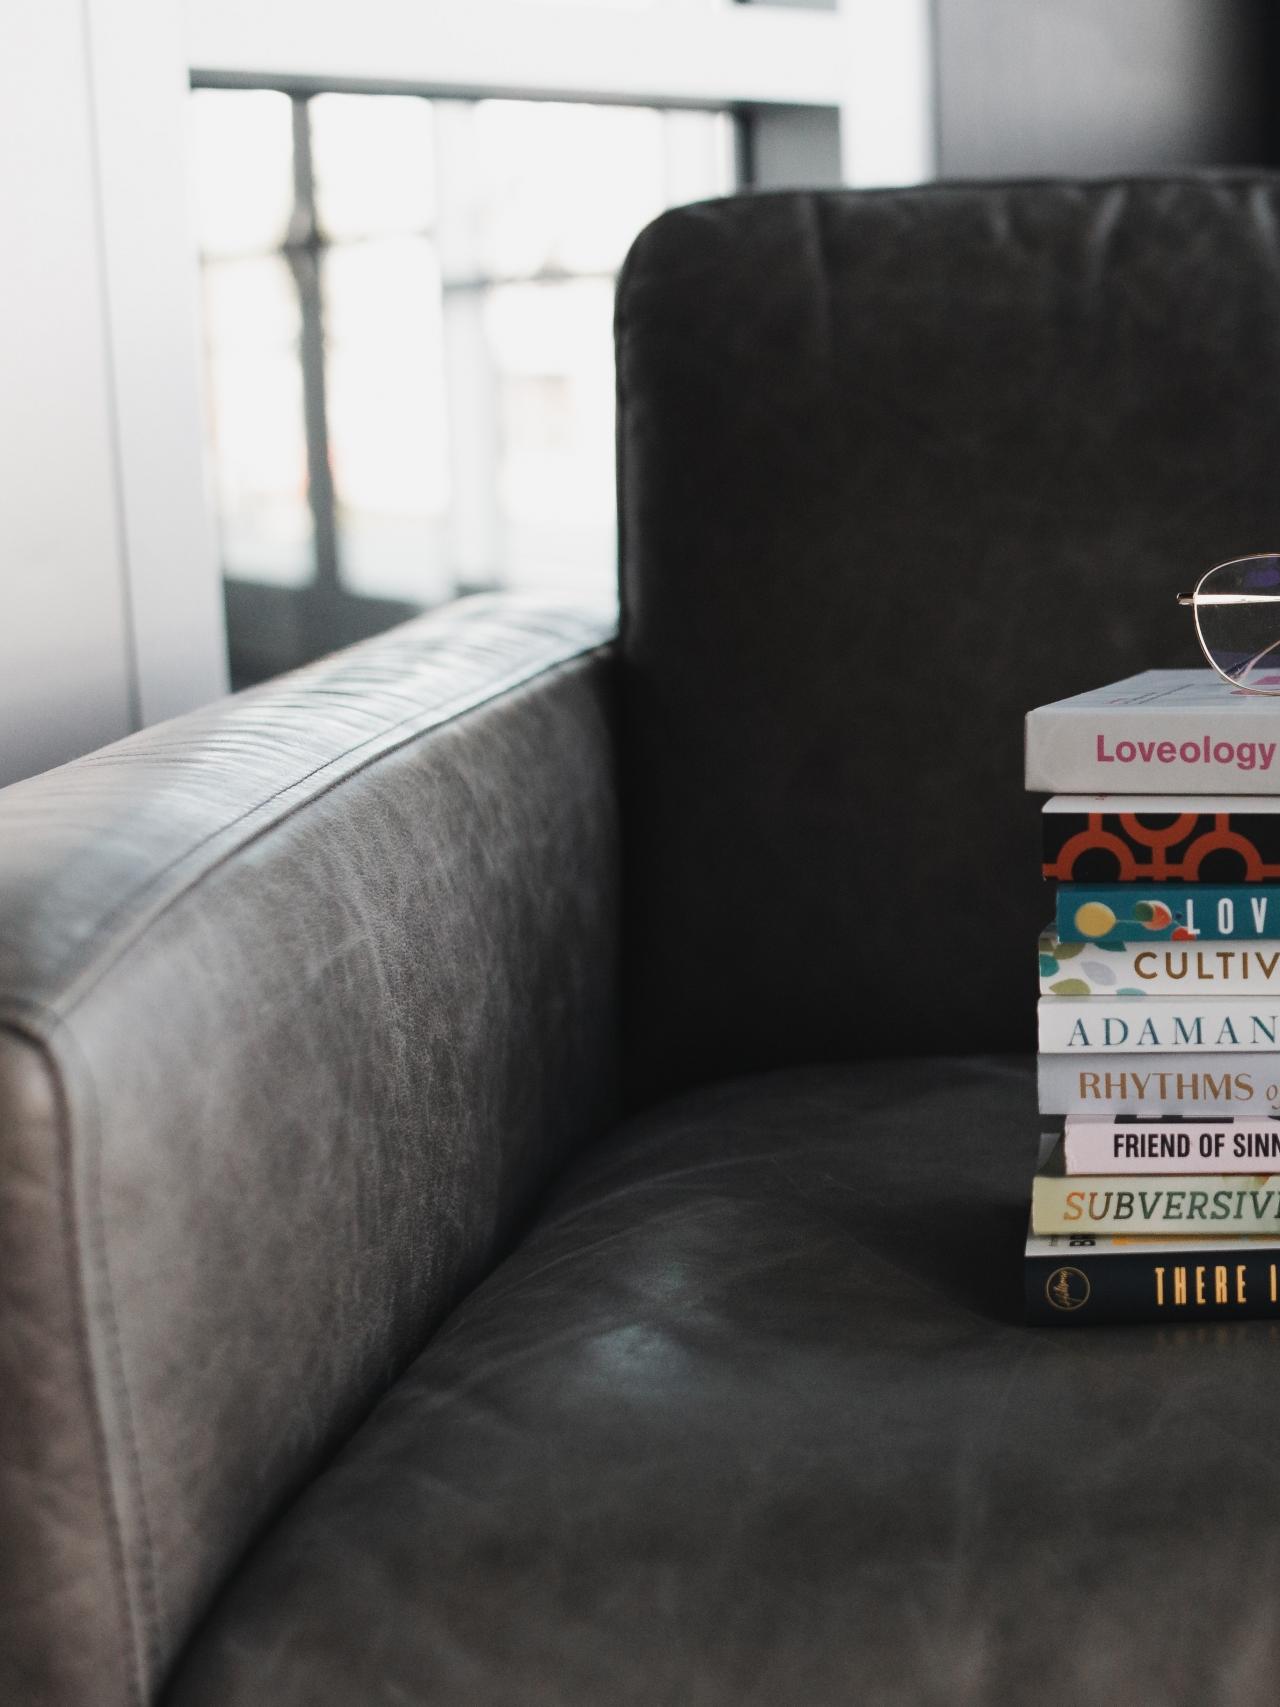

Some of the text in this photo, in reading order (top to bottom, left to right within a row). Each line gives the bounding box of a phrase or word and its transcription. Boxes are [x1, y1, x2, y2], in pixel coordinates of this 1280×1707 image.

[1096, 734, 1277, 771] Loveology
[1079, 1072, 1254, 1101] RHYTHMS
[1113, 1133, 1191, 1158] FRIEND
[1199, 1133, 1226, 1158] OF
[1155, 1264, 1247, 1306] THERE
